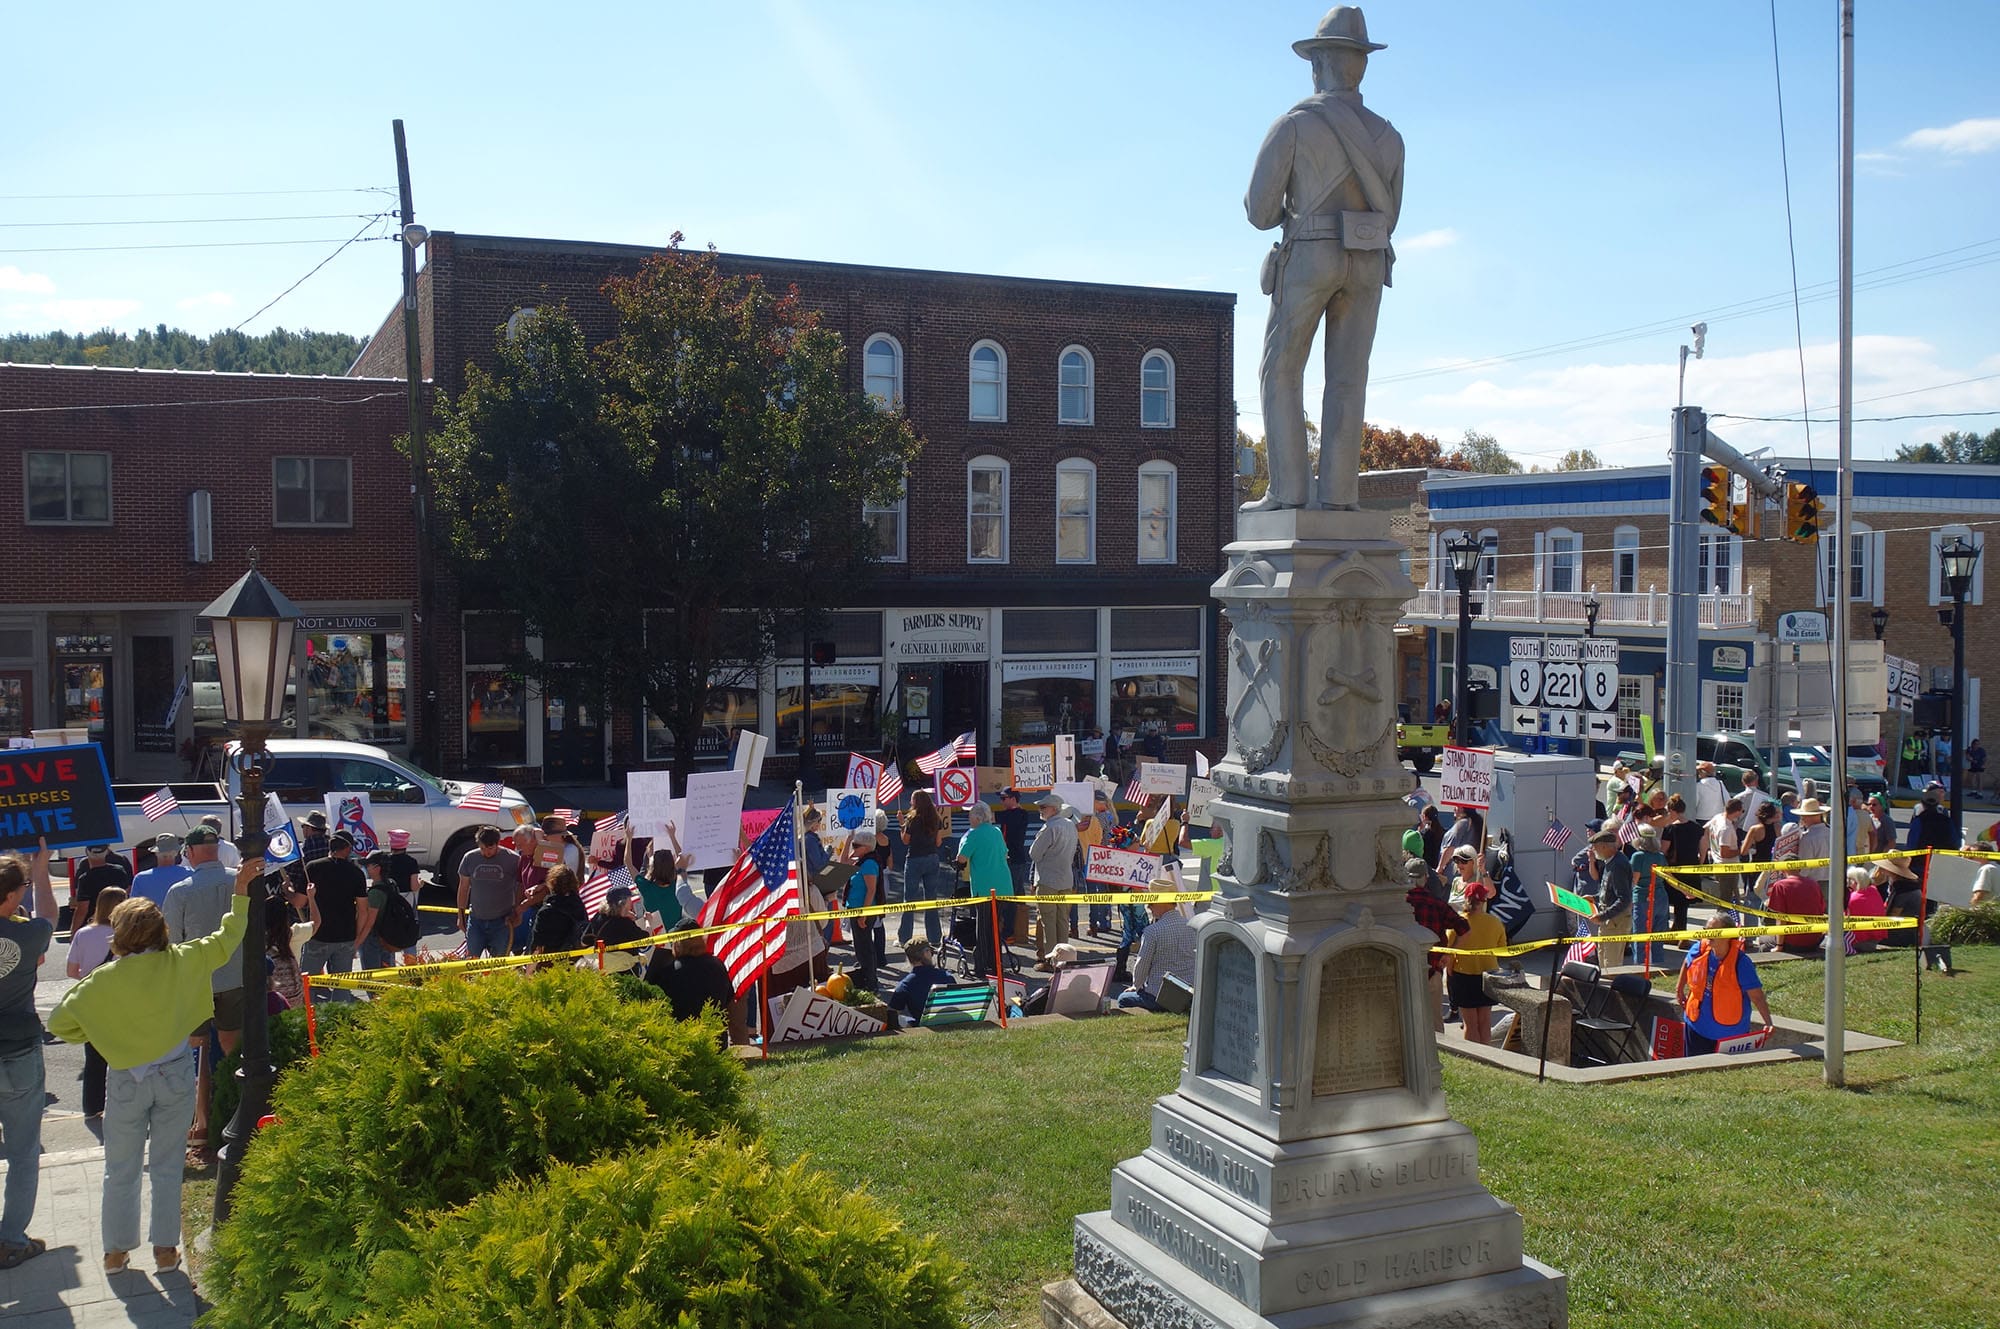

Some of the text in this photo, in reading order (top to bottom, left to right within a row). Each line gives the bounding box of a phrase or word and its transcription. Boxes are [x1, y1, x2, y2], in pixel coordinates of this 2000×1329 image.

[336, 617, 377, 628] LIVING
[949, 613, 984, 631] SUPPLY
[901, 641, 986, 655] GENERAL HARDWARE
[1512, 642, 1539, 656] SOUTH
[1549, 643, 1577, 657] SOUTH
[1586, 644, 1616, 658] NORTH
[1520, 669, 1529, 692] 8
[1547, 672, 1577, 697] 221
[1596, 672, 1606, 697] 8
[1890, 672, 1895, 684] 8
[1902, 678, 1917, 694] 221
[1015, 749, 1050, 764] Silence
[1446, 750, 1477, 769] STAND UP
[0, 759, 78, 788] OVE
[1019, 763, 1051, 774] WILL NOT
[1043, 773, 1053, 787] US
[1459, 769, 1490, 785] CONGRESS
[0, 790, 71, 807] CLIPSES
[1442, 784, 1465, 801] FOLLOW
[1466, 786, 1477, 801] THE
[835, 792, 872, 810] SAVE
[0, 807, 77, 837] HATE
[601, 834, 616, 847] WE
[596, 850, 617, 861] LOV
[1093, 850, 1112, 861] DUE
[1089, 863, 1125, 877] PROCESS
[1136, 857, 1154, 874] FOR
[1128, 869, 1150, 884] ALL
[1165, 1125, 1254, 1193] CEDAR RUN
[1276, 1152, 1475, 1204] DRURY'S BLUFF
[1128, 1195, 1240, 1284] CHICKAMAUGA
[1295, 1239, 1492, 1294] COLD HARBOR
